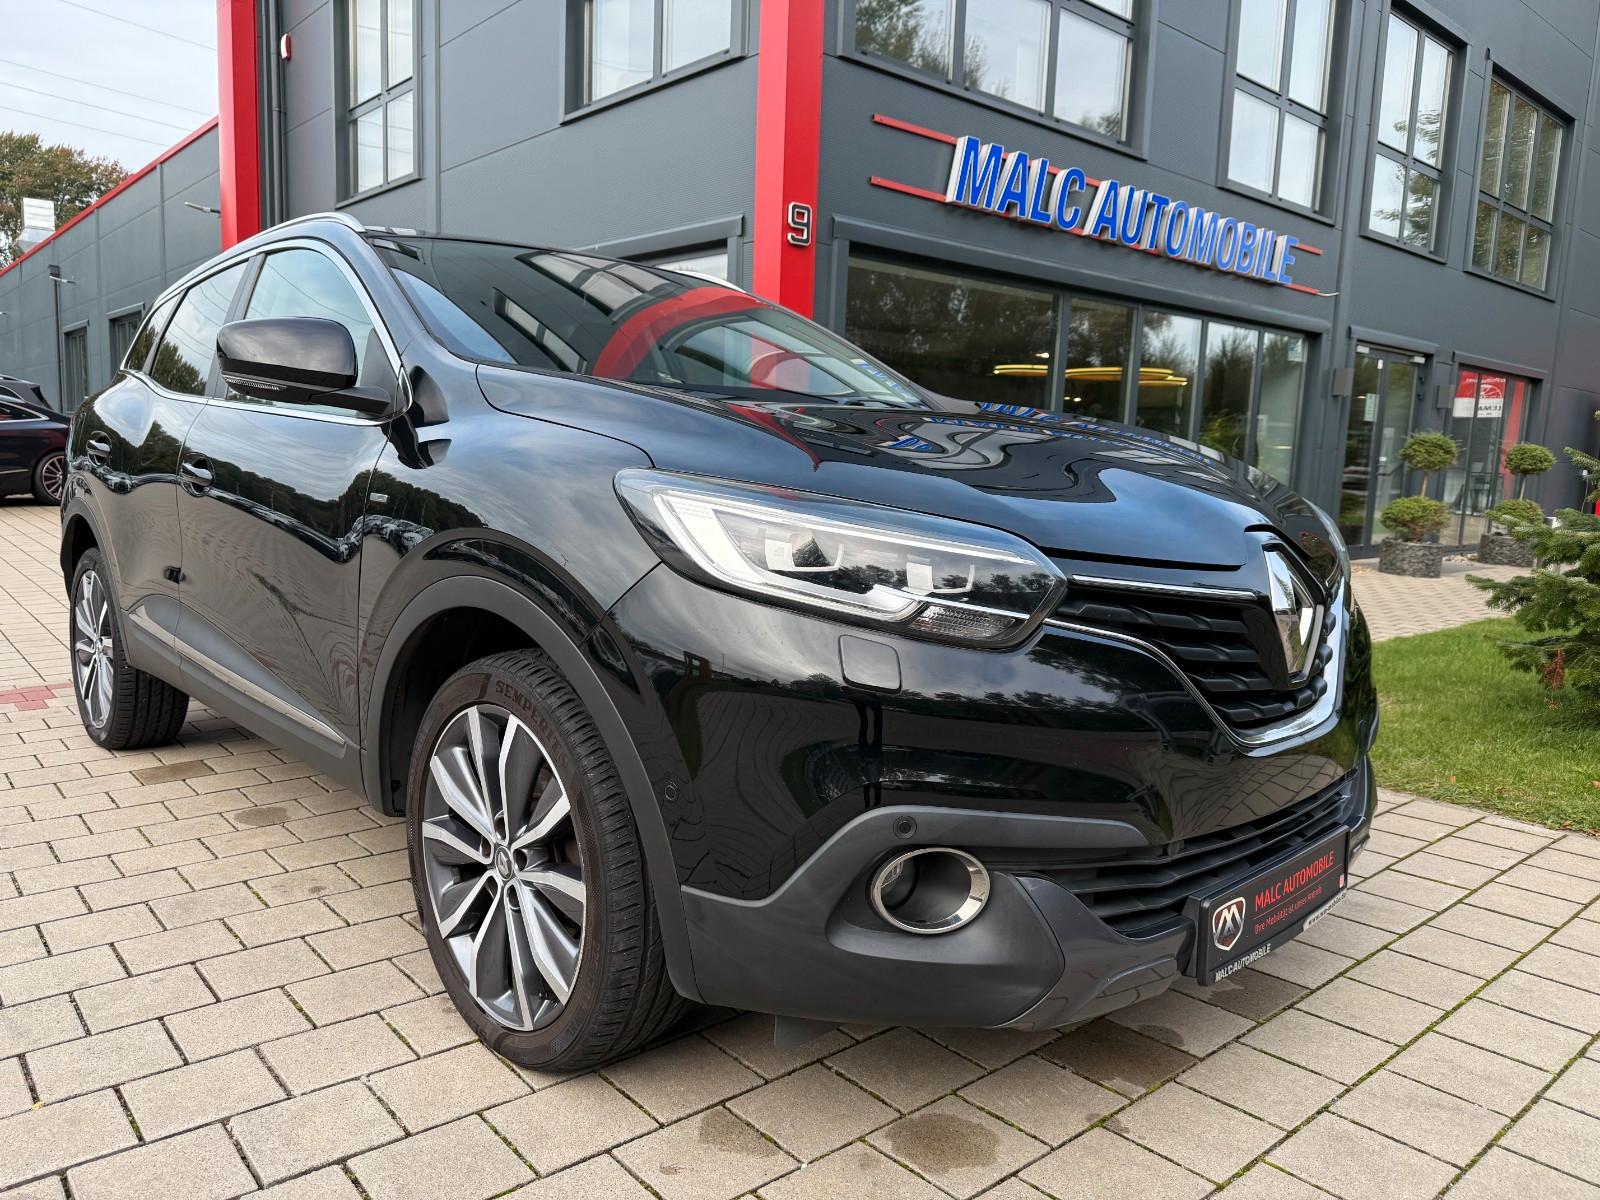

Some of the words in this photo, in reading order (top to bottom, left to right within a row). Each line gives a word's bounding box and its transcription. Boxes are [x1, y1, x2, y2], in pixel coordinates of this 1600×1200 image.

[787, 201, 812, 247] 9
[947, 136, 1085, 232] MALC
[1084, 179, 1299, 286] AUTOMOBILE
[1255, 882, 1282, 912] MALC
[1283, 850, 1334, 896] AUTOMOBILE
